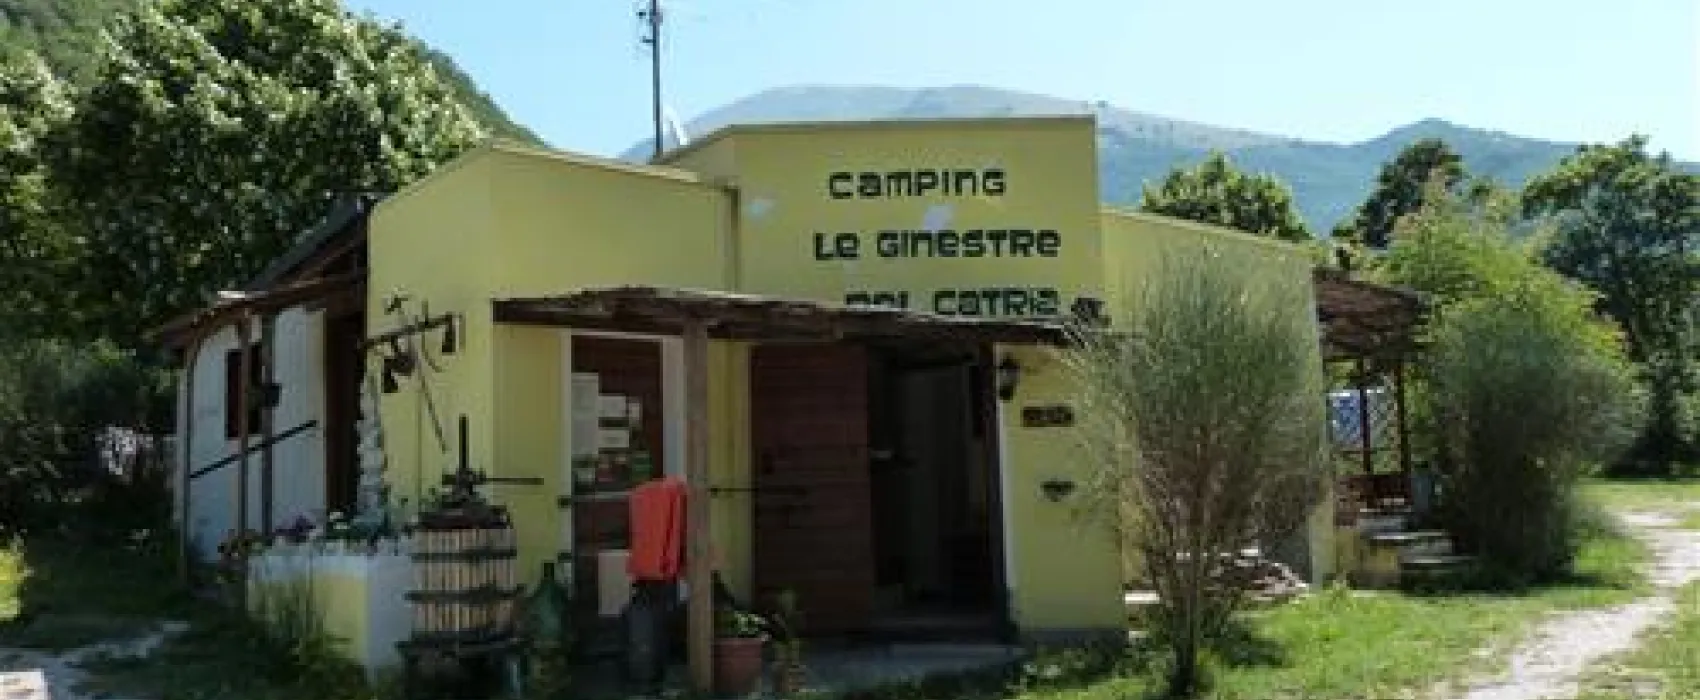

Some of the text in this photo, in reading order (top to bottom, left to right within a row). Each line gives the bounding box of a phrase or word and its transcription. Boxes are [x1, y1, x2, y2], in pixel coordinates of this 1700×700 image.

[829, 170, 1006, 199] CAMPING
[814, 229, 1061, 260] LE GINESTRE
